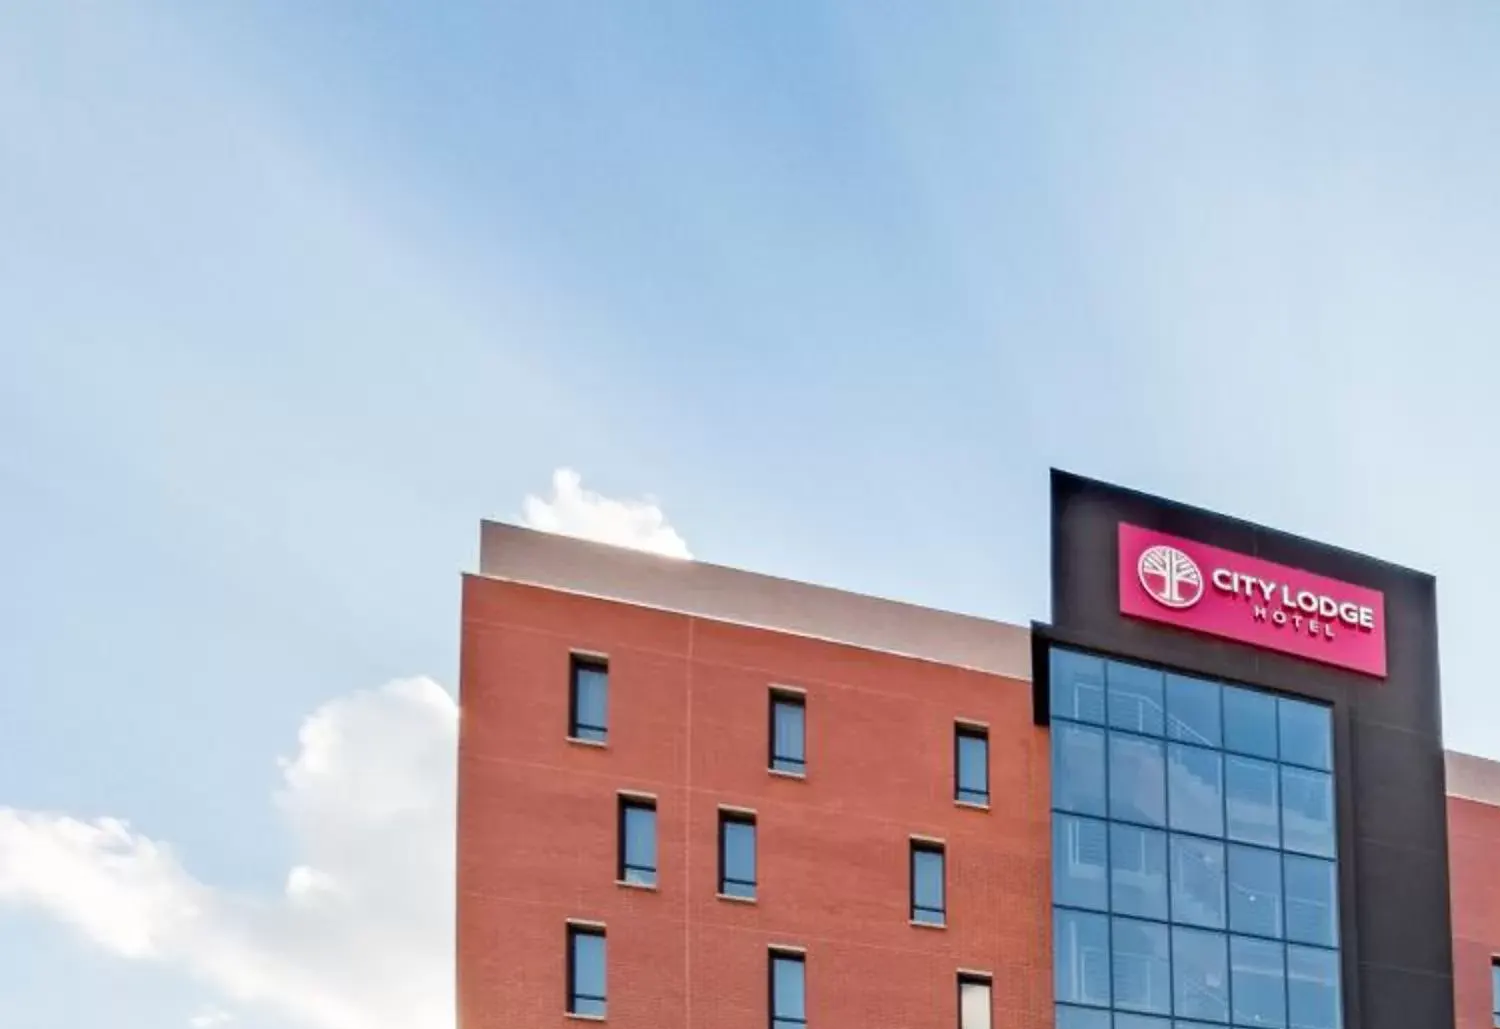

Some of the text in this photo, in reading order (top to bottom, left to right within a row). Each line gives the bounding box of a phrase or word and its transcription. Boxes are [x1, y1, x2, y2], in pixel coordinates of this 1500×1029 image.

[1212, 568, 1374, 628] CITY LODGE
[1254, 605, 1335, 637] HOTEL
